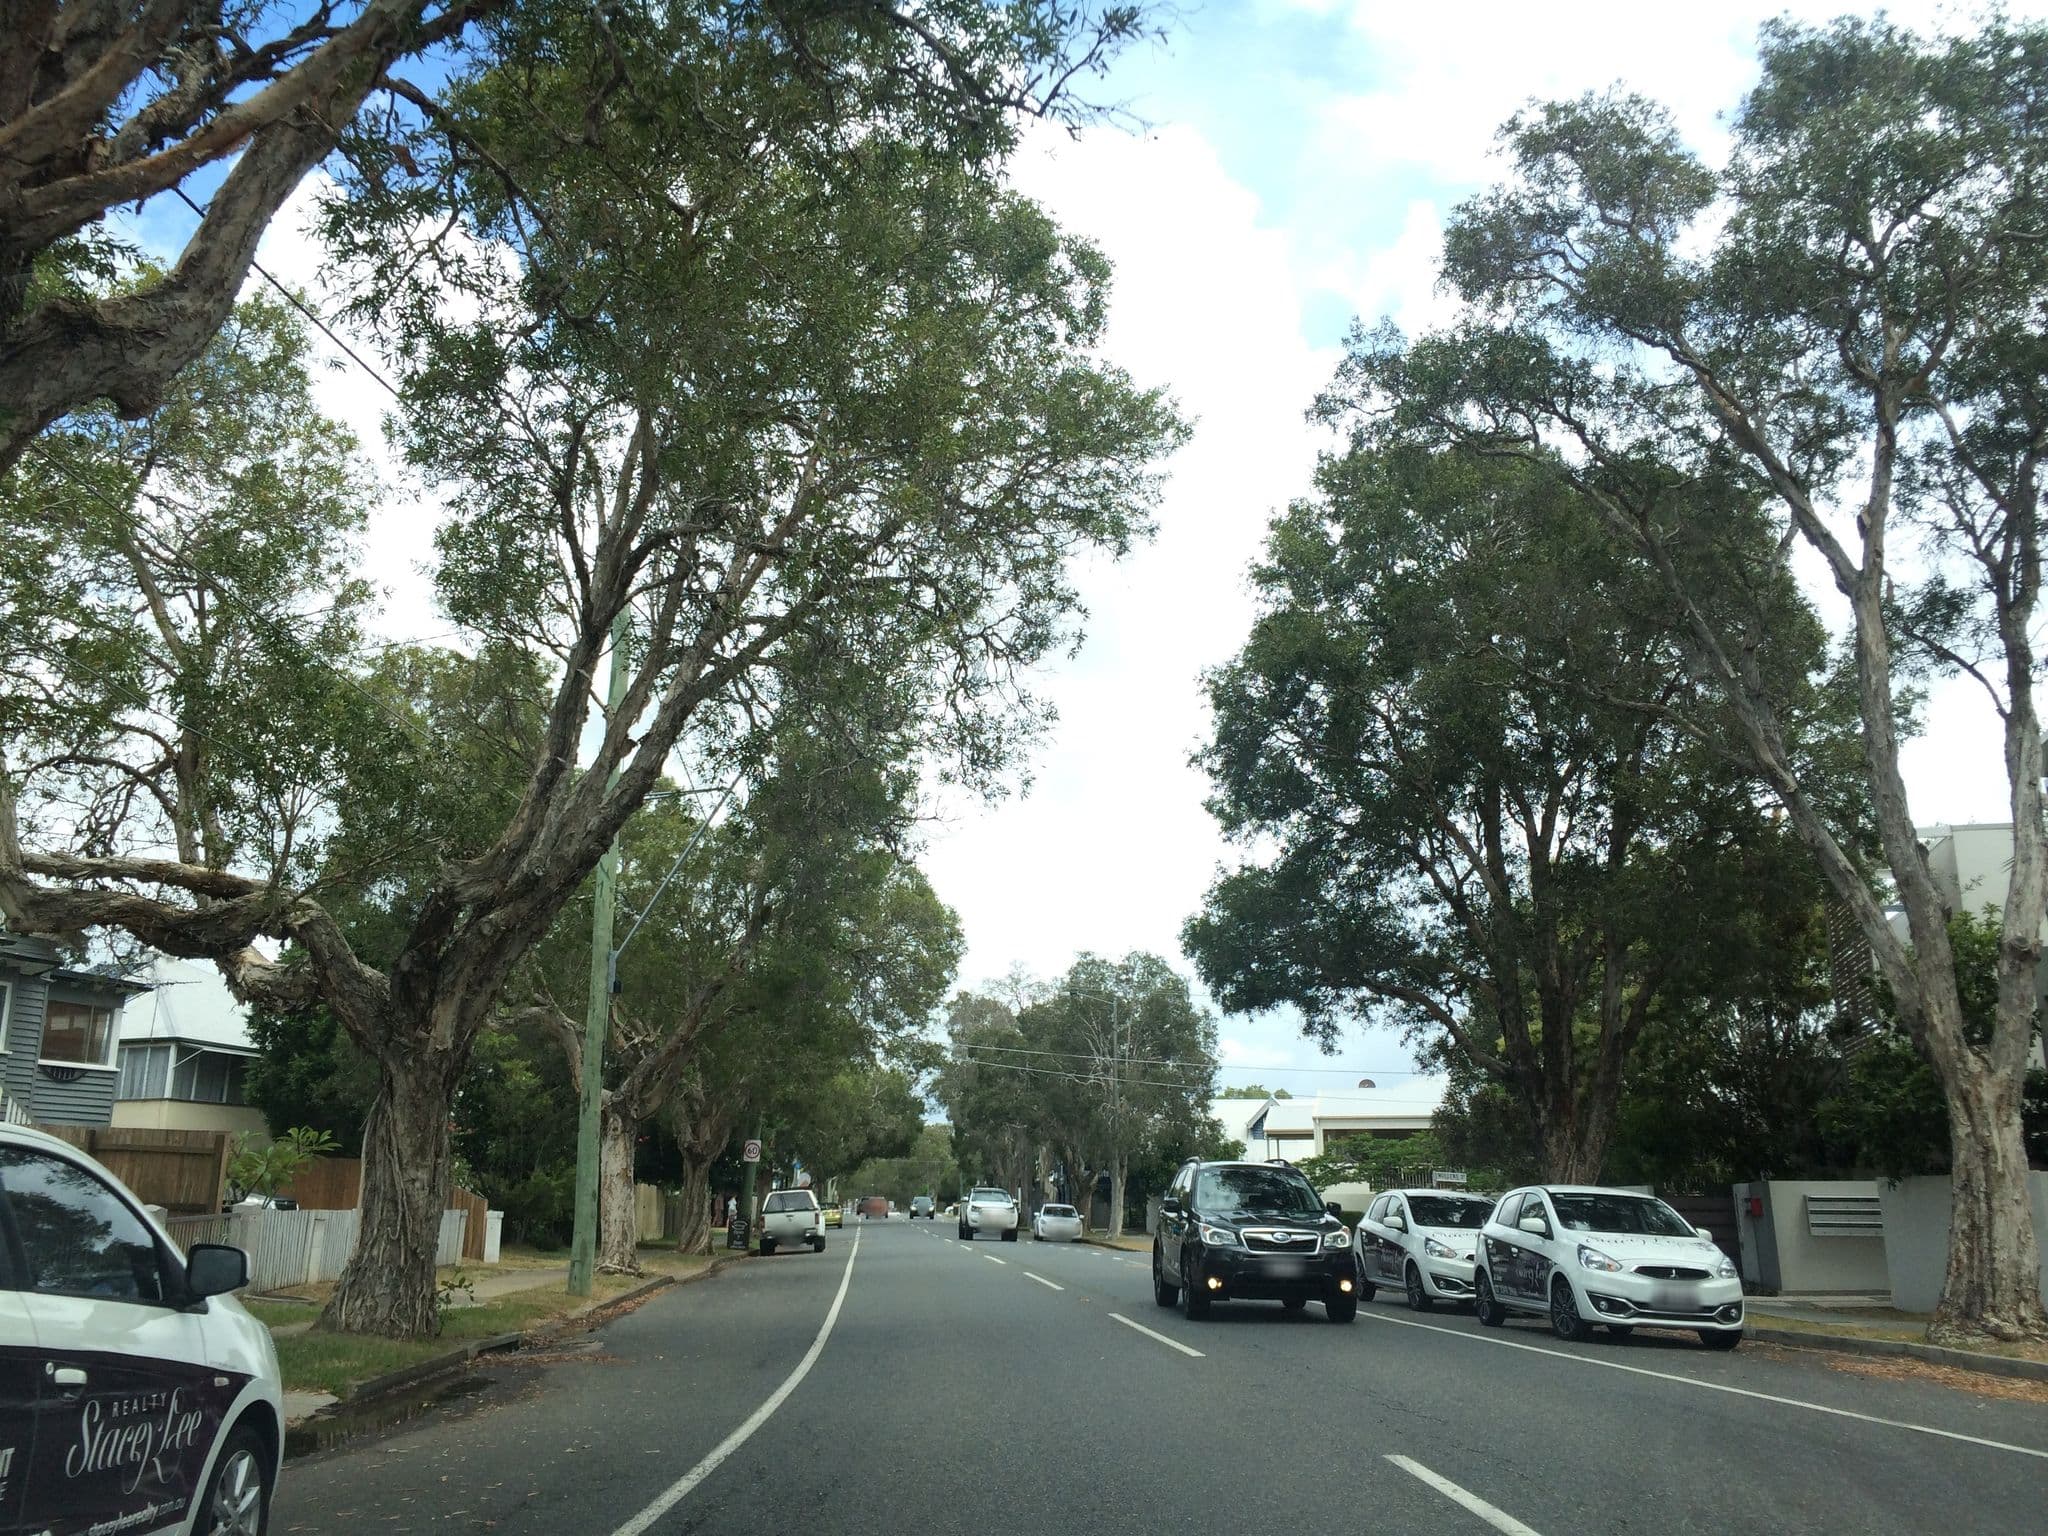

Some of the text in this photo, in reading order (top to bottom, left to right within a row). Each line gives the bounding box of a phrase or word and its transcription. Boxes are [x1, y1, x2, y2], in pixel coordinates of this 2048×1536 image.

[111, 1392, 168, 1418] REALTY
[65, 1386, 203, 1495] Stacey Lee
